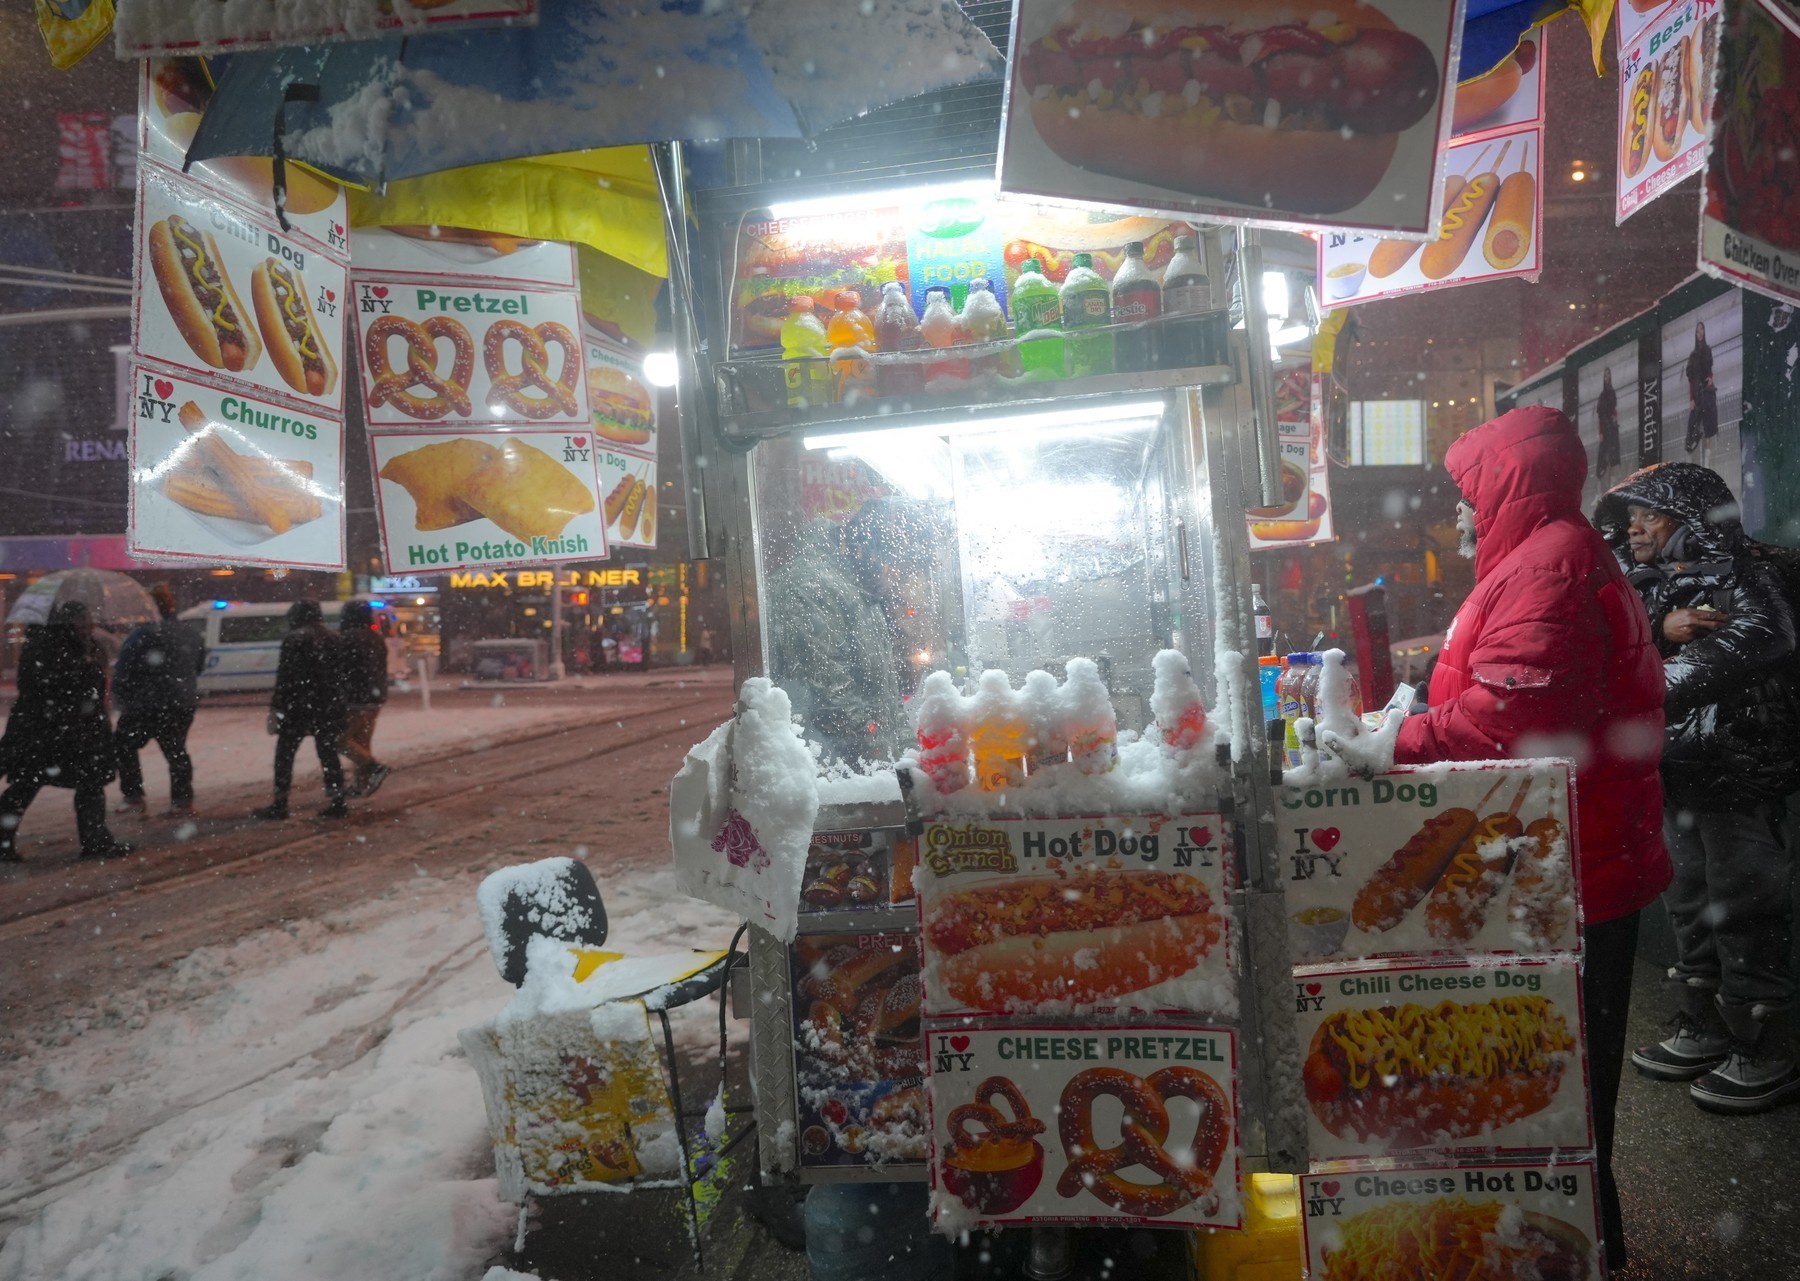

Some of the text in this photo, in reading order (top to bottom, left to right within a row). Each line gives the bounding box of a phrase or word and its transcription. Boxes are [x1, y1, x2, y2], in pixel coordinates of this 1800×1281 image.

[1649, 3, 1693, 56] Best
[1624, 57, 1642, 83] NY
[1625, 56, 1631, 70] I
[1645, 164, 1677, 194] Cheese
[327, 230, 346, 249] NY
[1329, 232, 1364, 249] N
[267, 234, 305, 271] Dog
[1724, 233, 1800, 286] Chicken Over
[923, 260, 987, 284] FOOD
[319, 285, 326, 300] I
[361, 284, 372, 299] I
[416, 289, 529, 315] Pretzel
[316, 299, 337, 318] NY
[360, 299, 393, 314] NY
[142, 374, 154, 397] I
[138, 396, 177, 424] NY
[220, 397, 318, 440] Churros
[1643, 377, 1659, 453] Matin
[563, 436, 572, 450] I
[1286, 444, 1305, 456] Dog
[563, 449, 591, 463] NY
[606, 453, 627, 471] Dog
[408, 534, 589, 566] Hot Potato Knish
[450, 571, 509, 588] MAX
[1280, 779, 1438, 810] Corn Dog
[927, 824, 1008, 849] Onion
[1023, 829, 1160, 862] Hot Dog
[1177, 827, 1189, 848] I
[1294, 828, 1311, 855] I
[1173, 846, 1218, 867] NY
[1290, 852, 1348, 881] NY
[1296, 983, 1306, 998] I
[1339, 970, 1542, 997] Chili Cheese Dog
[1296, 996, 1326, 1013] NY
[936, 1035, 948, 1054] I
[997, 1037, 1224, 1062] CHEESE PRETZEL
[934, 1053, 975, 1073] NY
[1310, 1182, 1321, 1199] I
[1354, 1170, 1578, 1198] Cheese Hot Dog
[1307, 1198, 1346, 1217] NY
